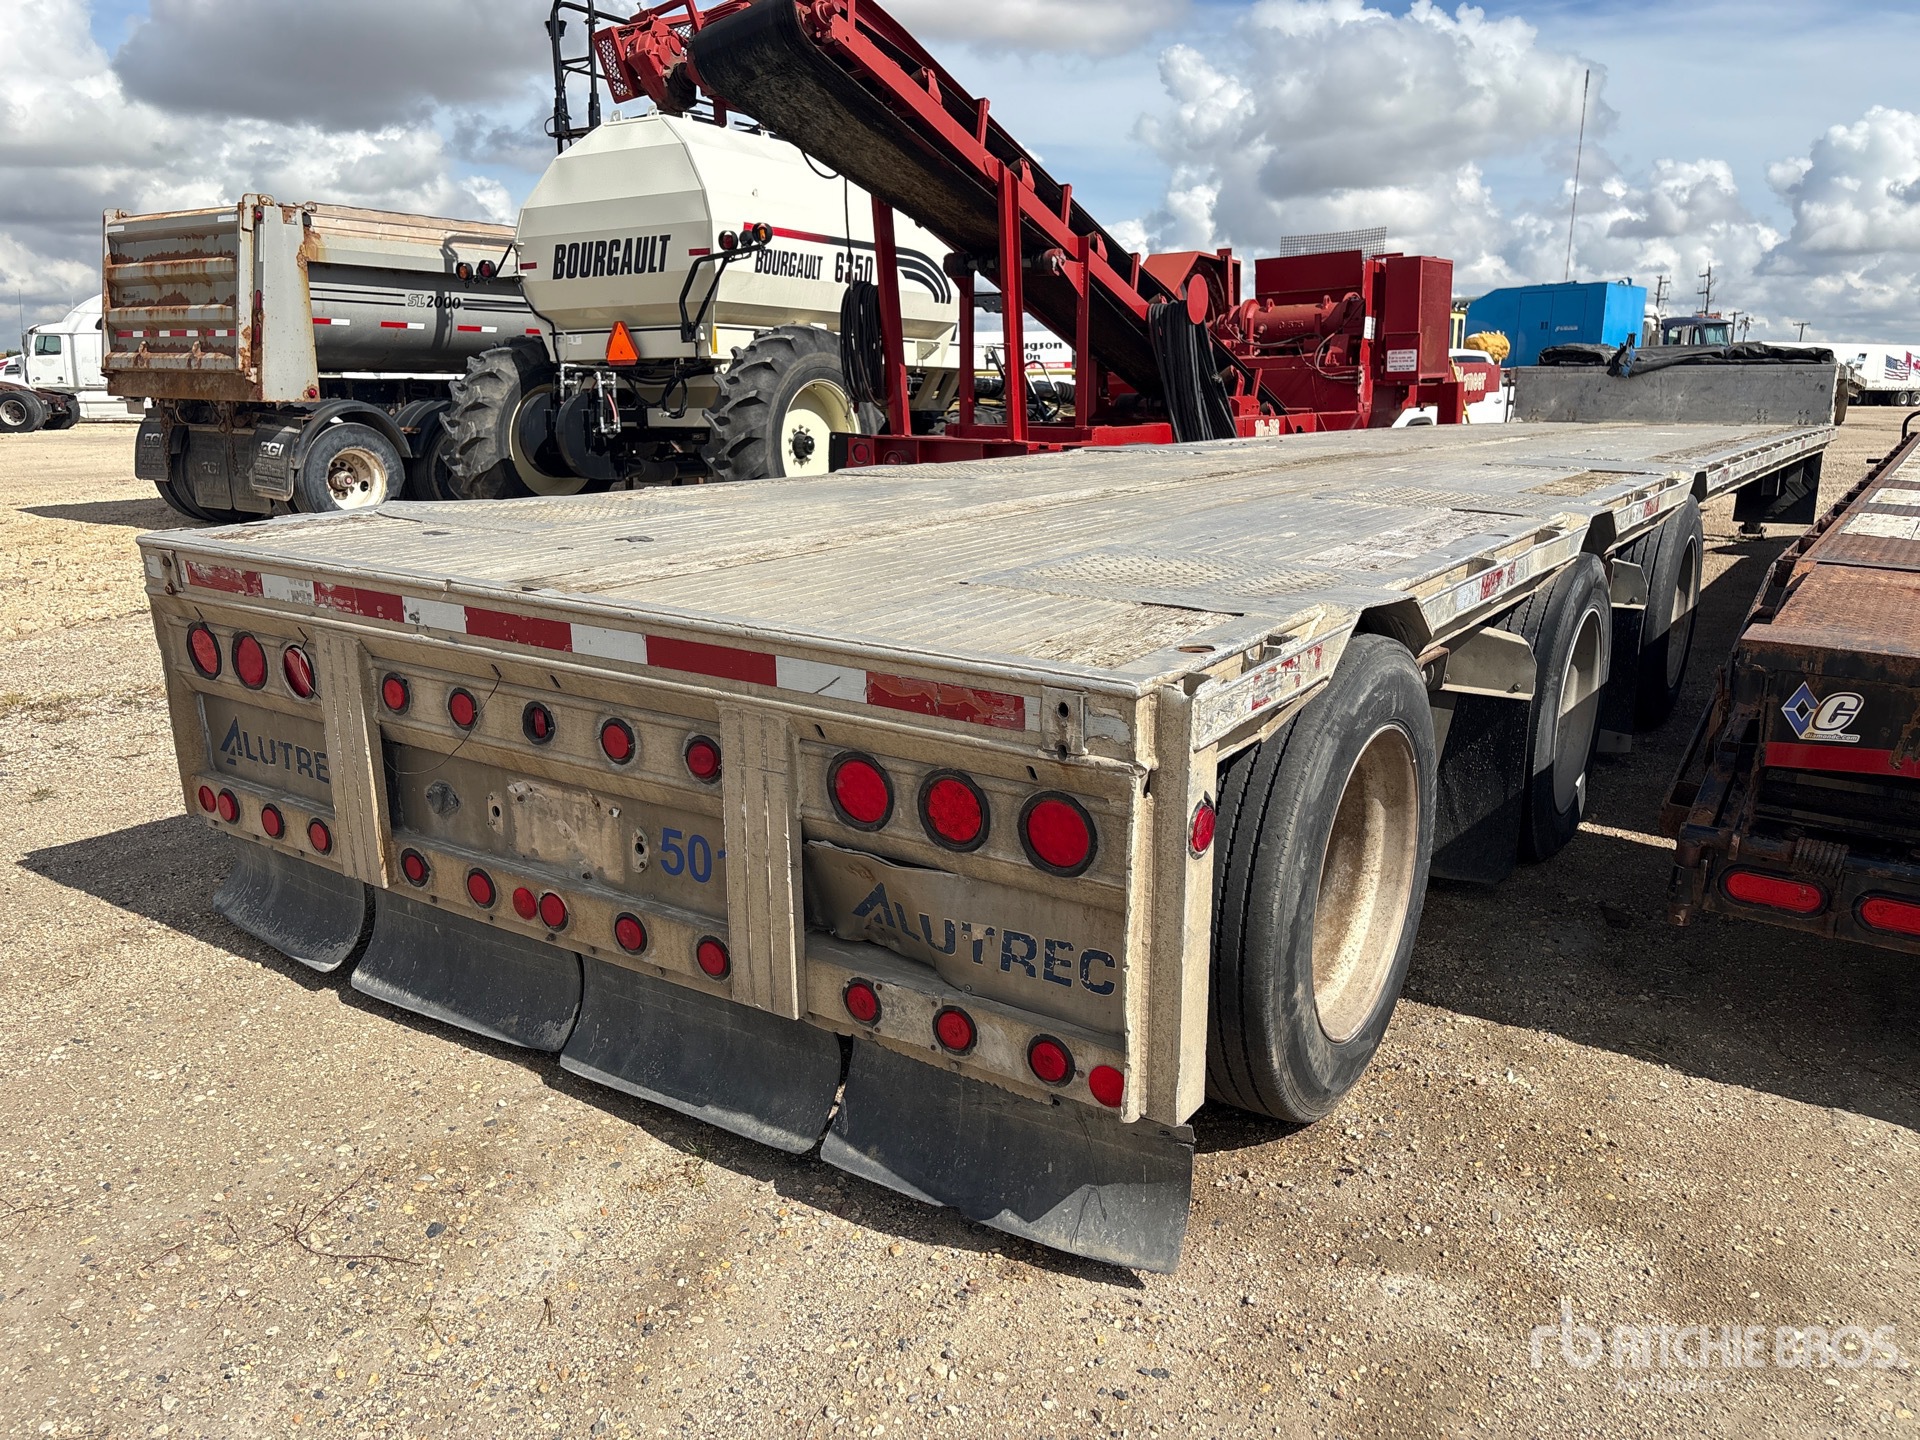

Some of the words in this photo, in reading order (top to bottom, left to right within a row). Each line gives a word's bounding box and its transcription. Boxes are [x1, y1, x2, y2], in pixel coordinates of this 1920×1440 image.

[552, 234, 671, 280] BOURGAULT
[754, 249, 823, 280] BOURGAULT
[1804, 731, 1859, 741] diamondc.com
[660, 827, 726, 884] 50
[852, 882, 1117, 996] ALUTREC
